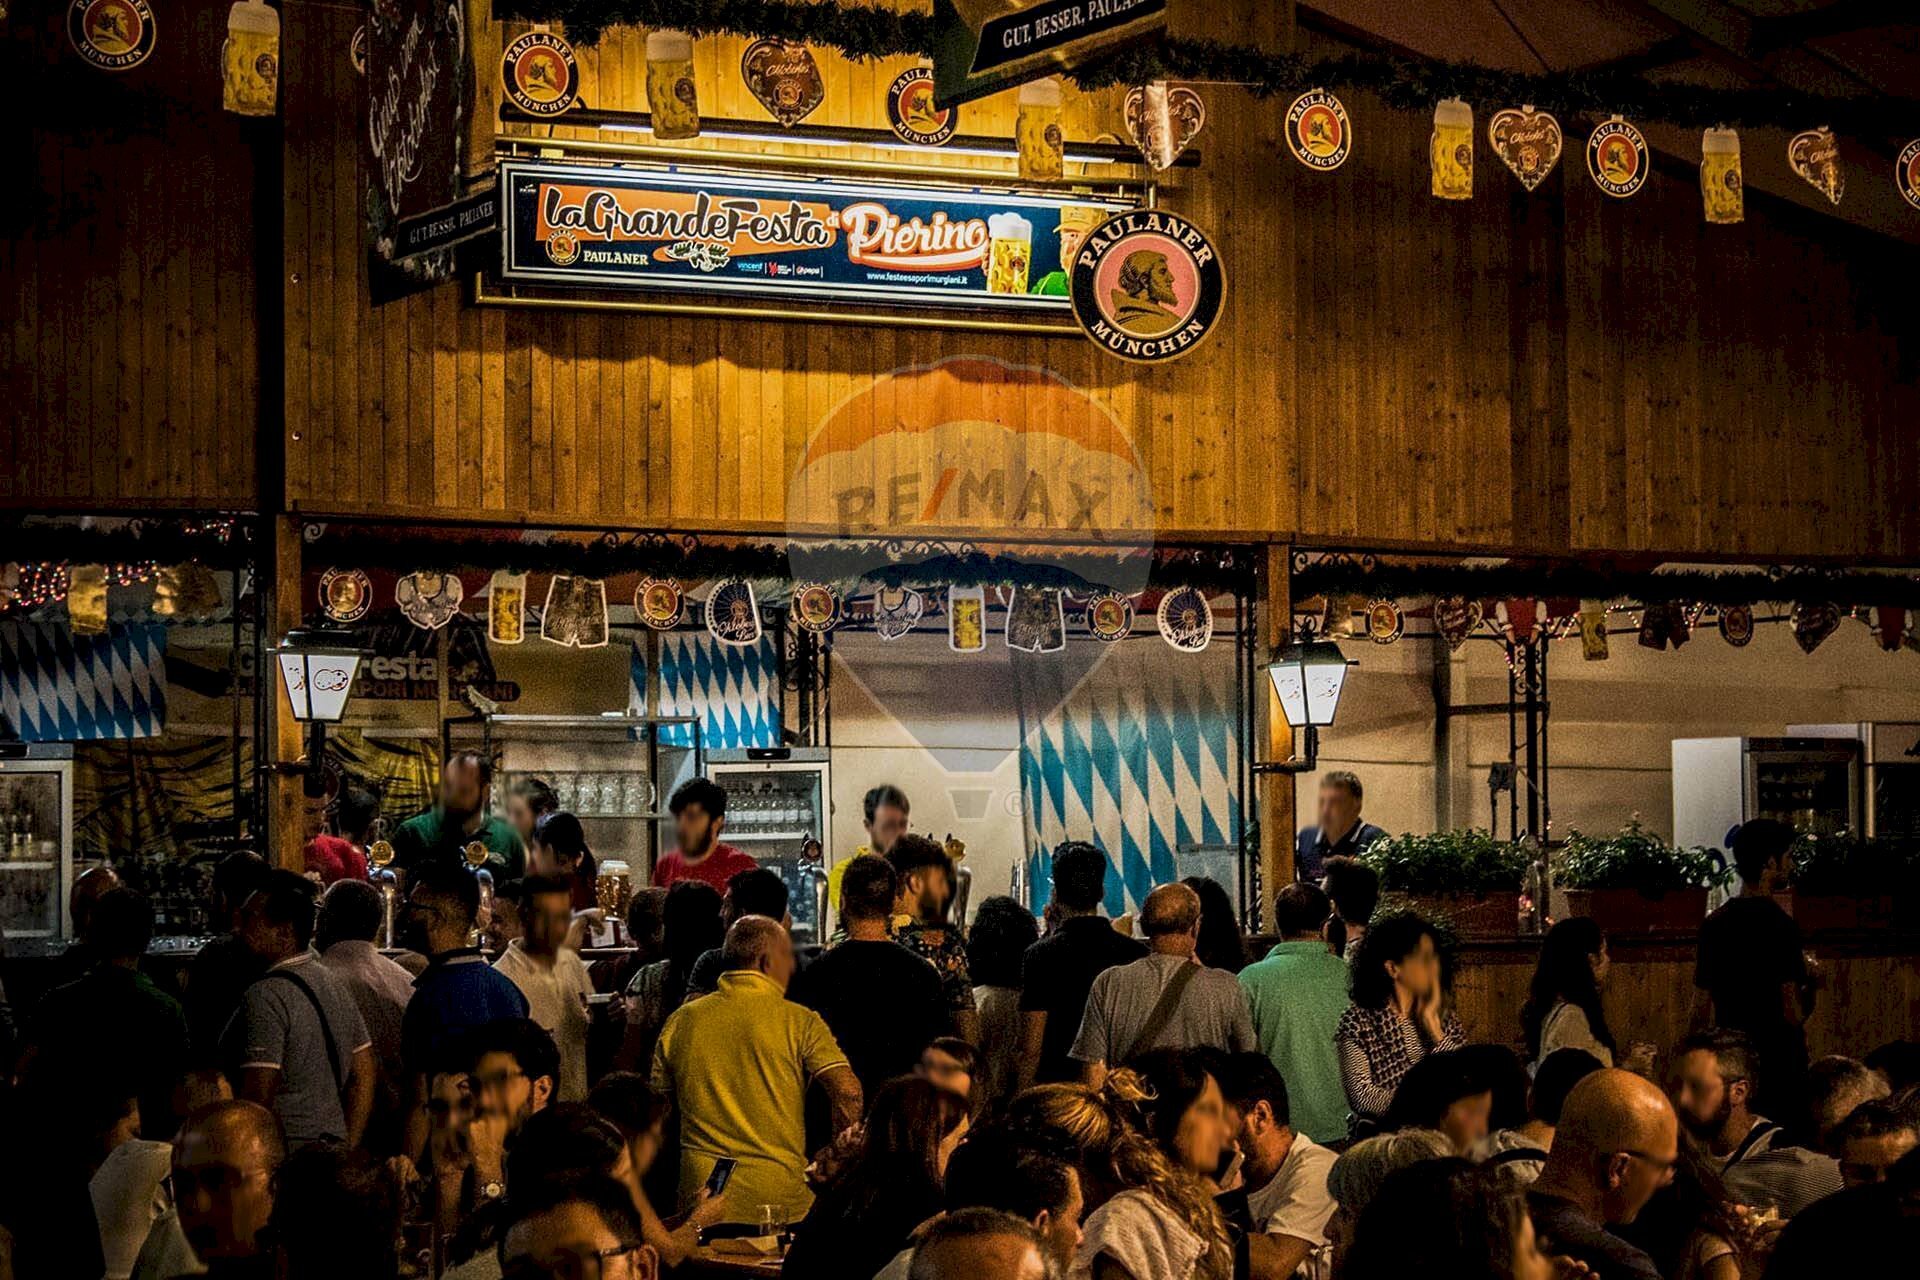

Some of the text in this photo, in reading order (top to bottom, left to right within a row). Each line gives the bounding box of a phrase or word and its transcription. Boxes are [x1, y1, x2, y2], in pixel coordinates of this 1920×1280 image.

[1002, 23, 1031, 49] GUT,
[1034, 6, 1086, 39] BESSER,
[506, 35, 575, 66] PAULANER
[891, 69, 933, 95] PAULA
[1290, 95, 1345, 122] PAULANER
[1591, 124, 1644, 152] PAULANER
[845, 203, 986, 256] Pierino
[1079, 214, 1214, 269] PAULANER
[583, 251, 649, 265] PAULANER
[1091, 319, 1205, 357] MÜNCHEN
